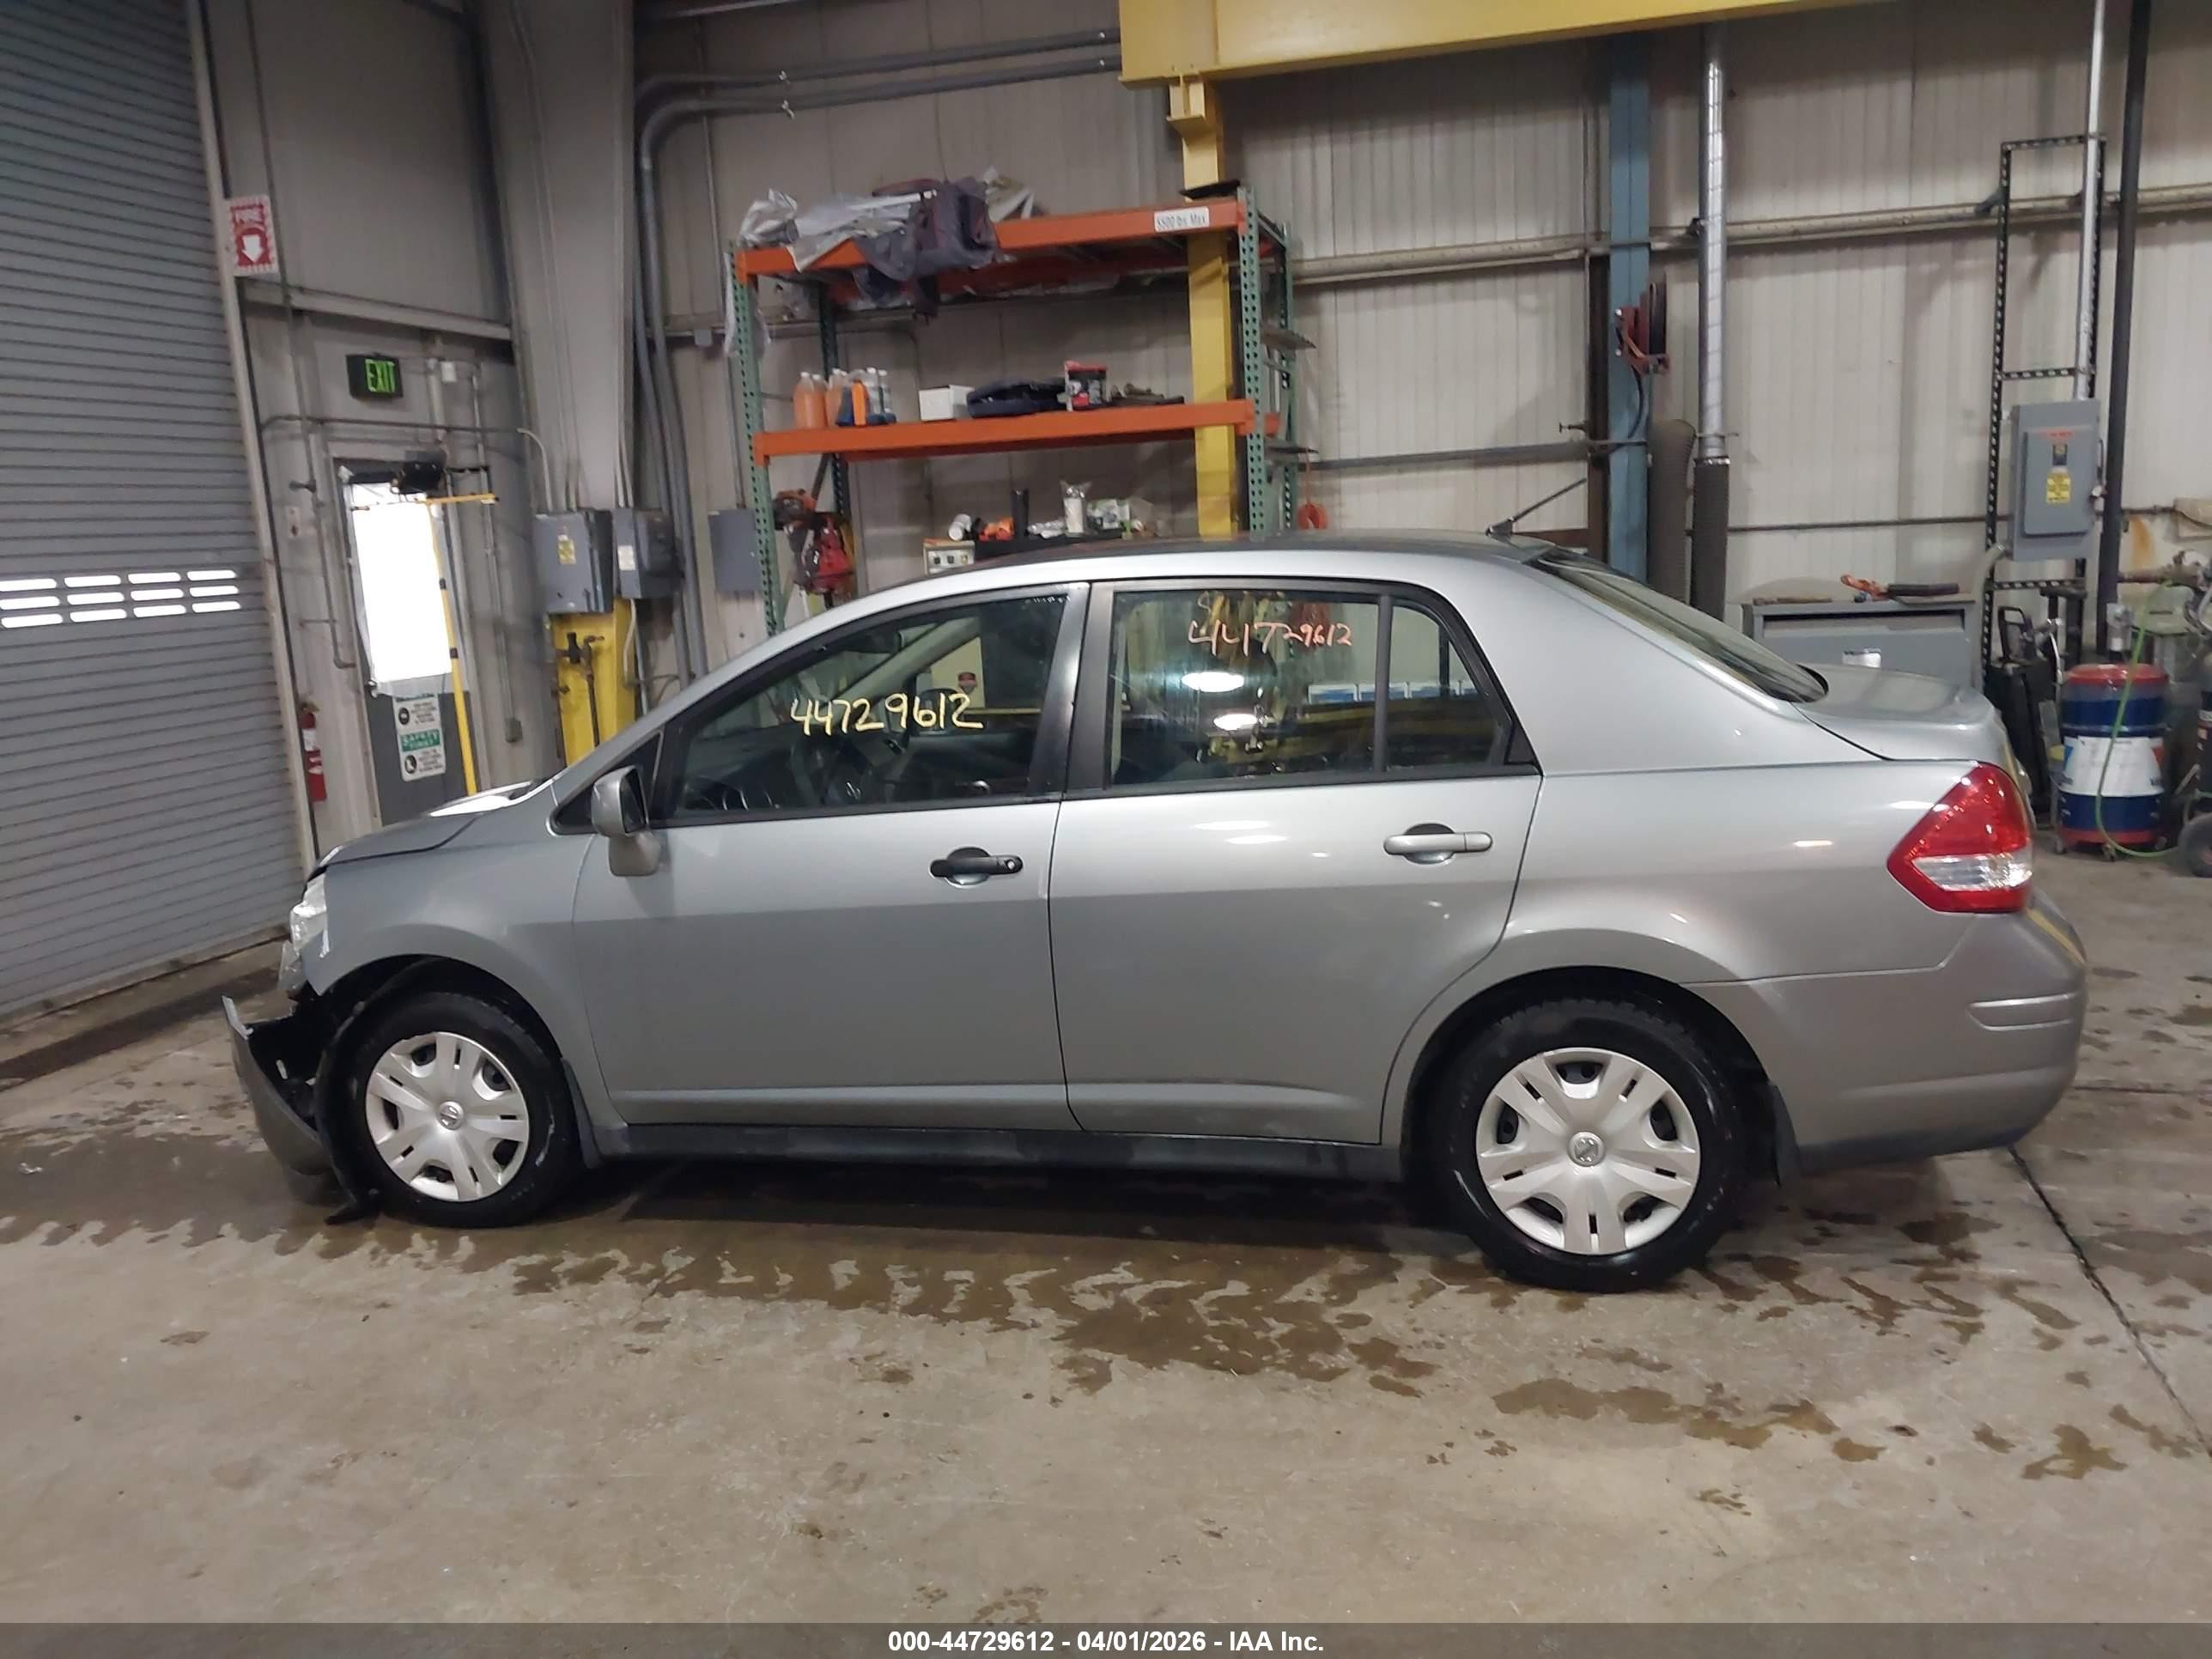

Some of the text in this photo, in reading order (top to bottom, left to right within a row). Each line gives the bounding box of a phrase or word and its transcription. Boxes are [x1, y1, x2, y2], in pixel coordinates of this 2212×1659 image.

[365, 359, 396, 392] EXIT
[1188, 619, 1352, 656] 44729612
[790, 693, 983, 736] 44729612
